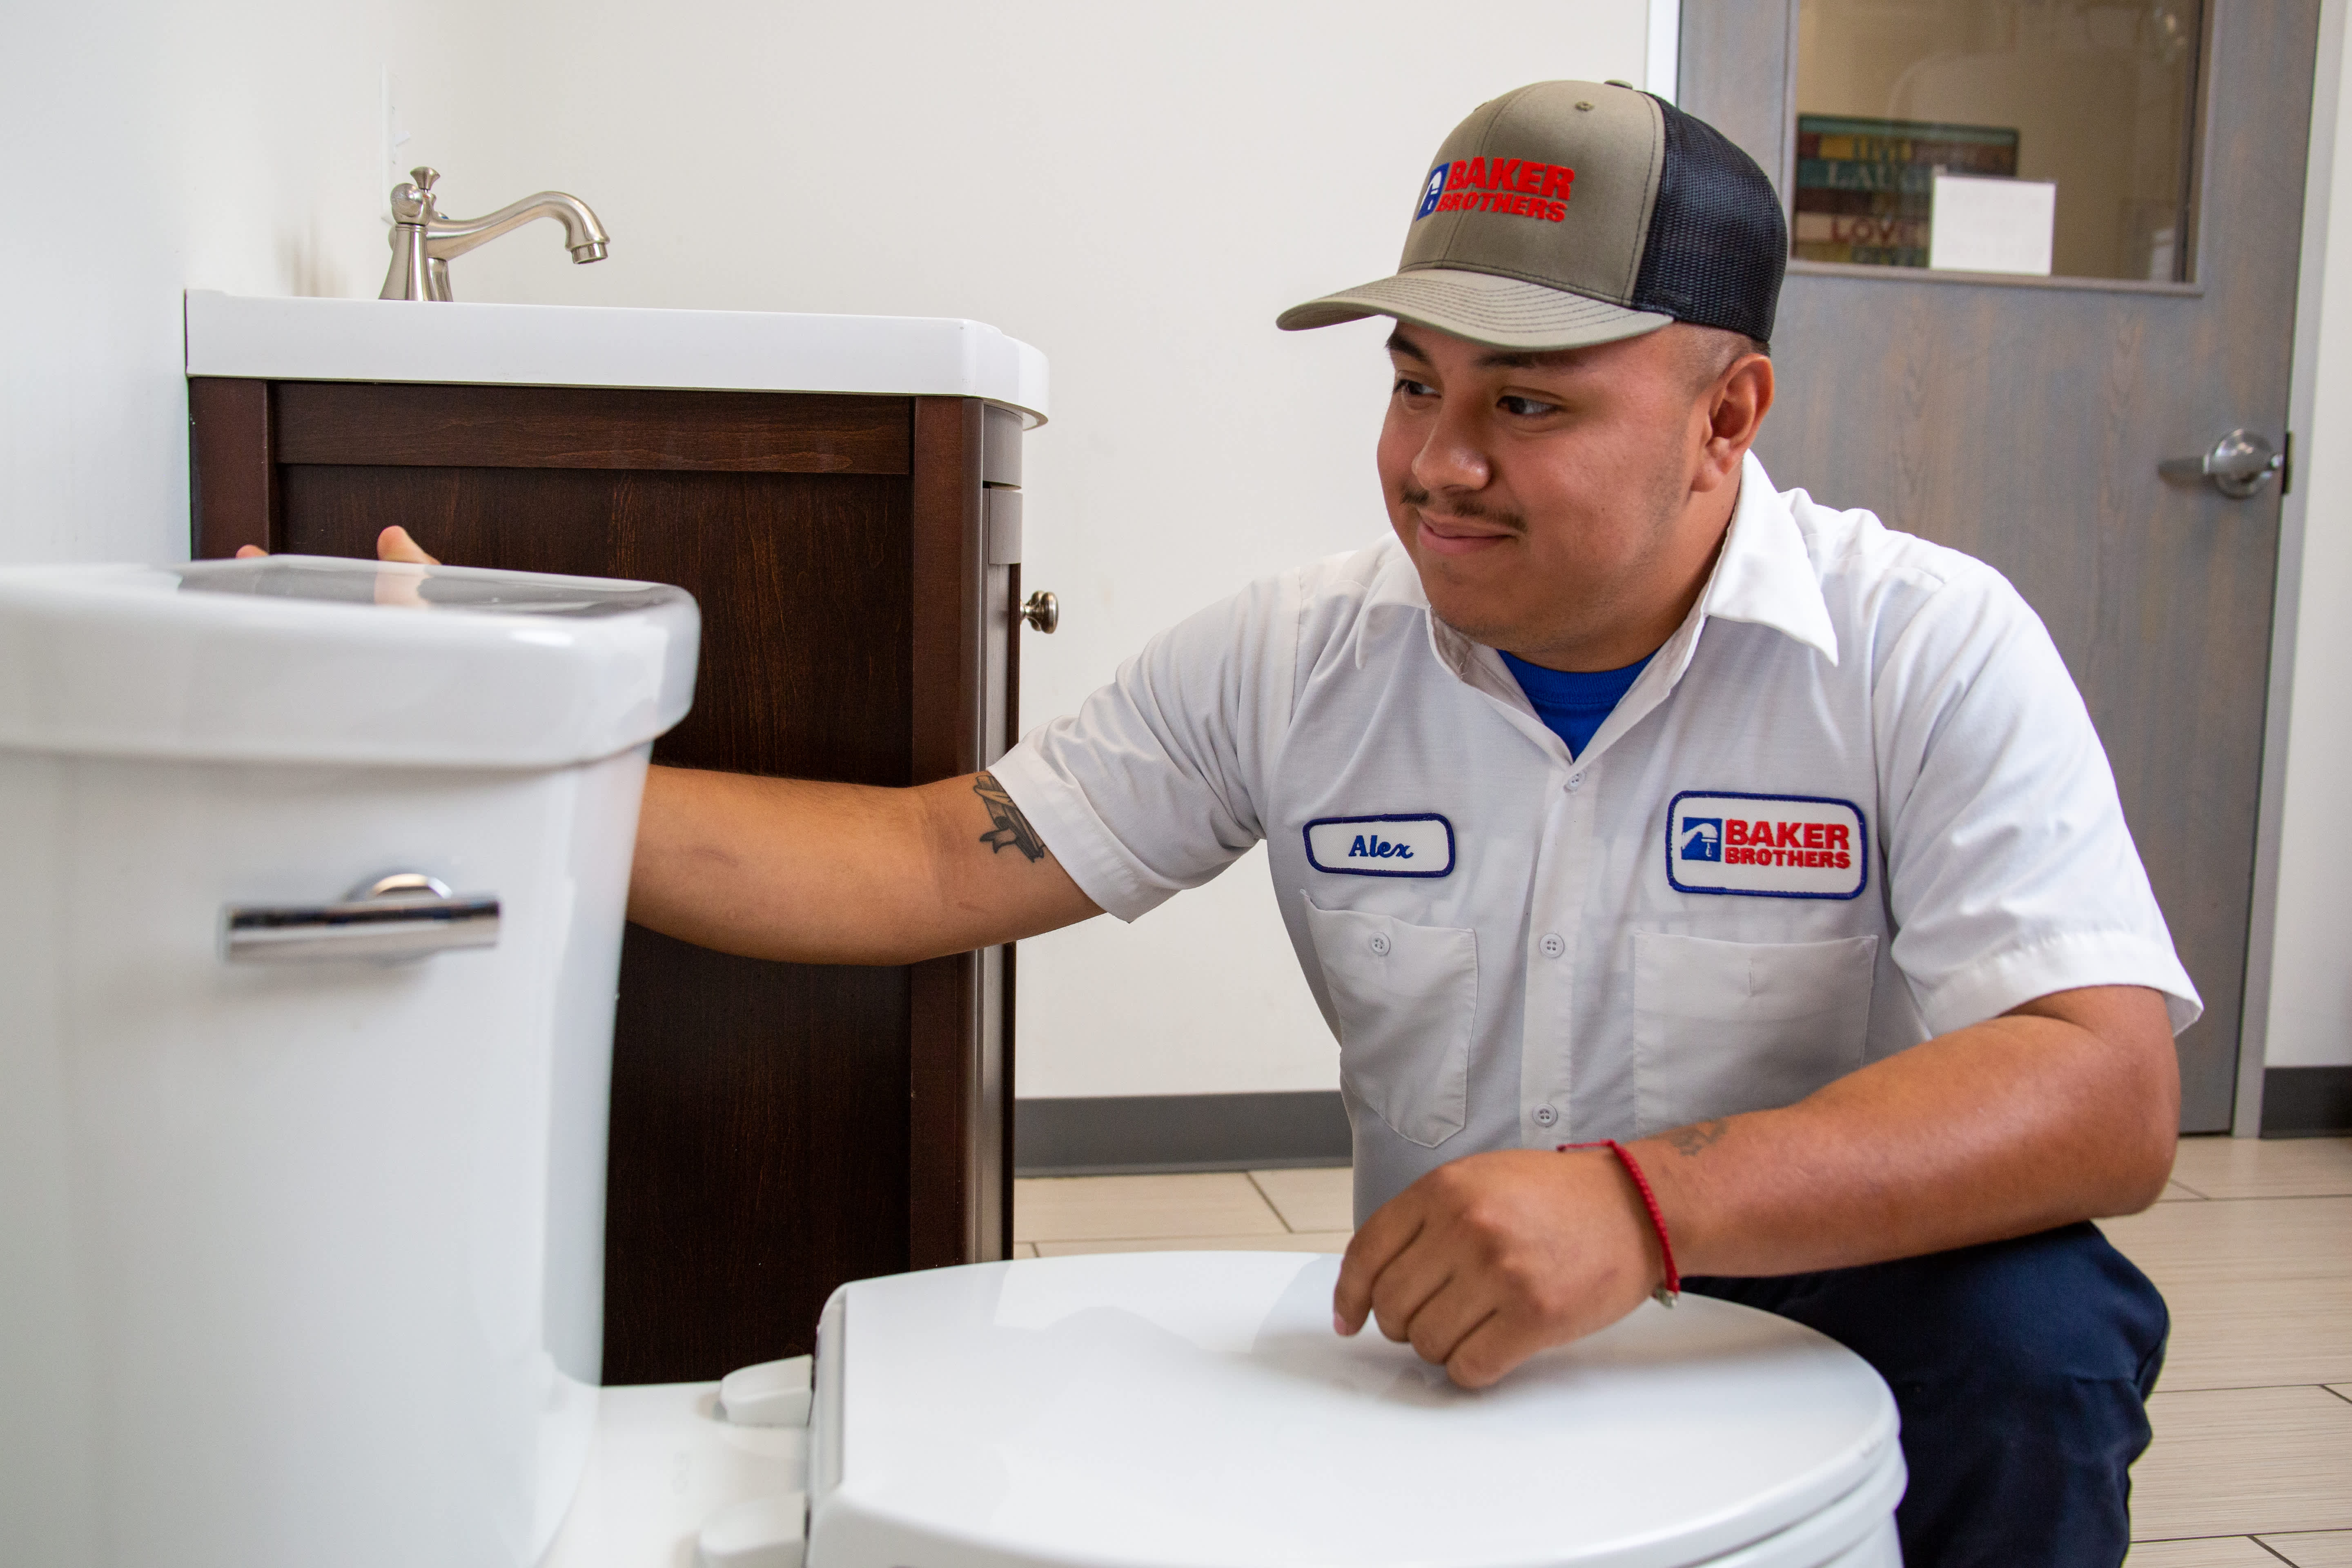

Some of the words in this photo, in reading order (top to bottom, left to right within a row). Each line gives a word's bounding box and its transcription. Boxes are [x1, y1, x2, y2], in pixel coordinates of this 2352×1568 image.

[1445, 156, 1575, 201] BAKER
[1435, 192, 1568, 223] BROTHERS
[1348, 835, 1414, 859] Alex
[1726, 819, 1850, 850] BAKER
[1725, 847, 1851, 869] BROTHERS
